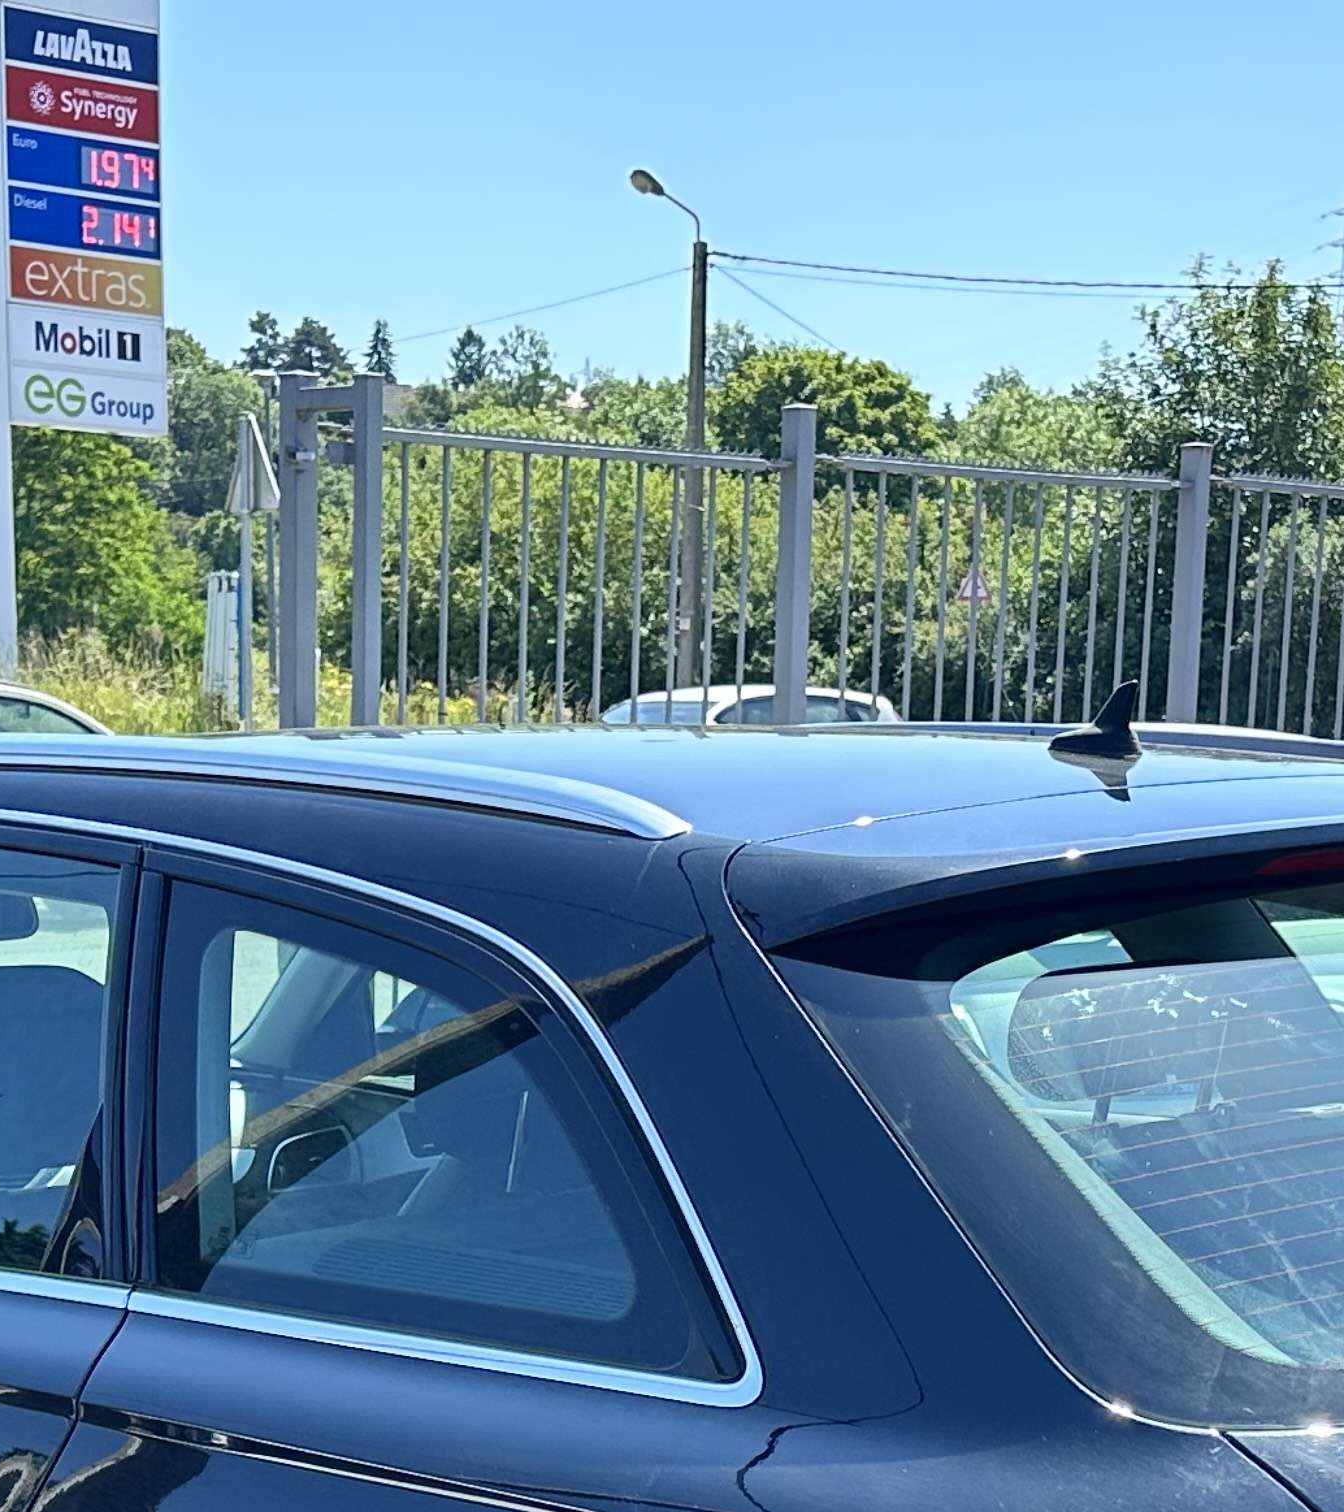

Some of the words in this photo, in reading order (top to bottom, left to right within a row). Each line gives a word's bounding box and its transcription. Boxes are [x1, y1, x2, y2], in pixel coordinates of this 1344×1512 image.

[33, 28, 132, 71] LAVAZZA
[60, 90, 138, 129] Synergy
[12, 133, 38, 149] Euro
[13, 193, 47, 211] Diesel
[25, 258, 146, 308] extras
[35, 321, 111, 359] Mobil
[91, 391, 154, 425] Group
